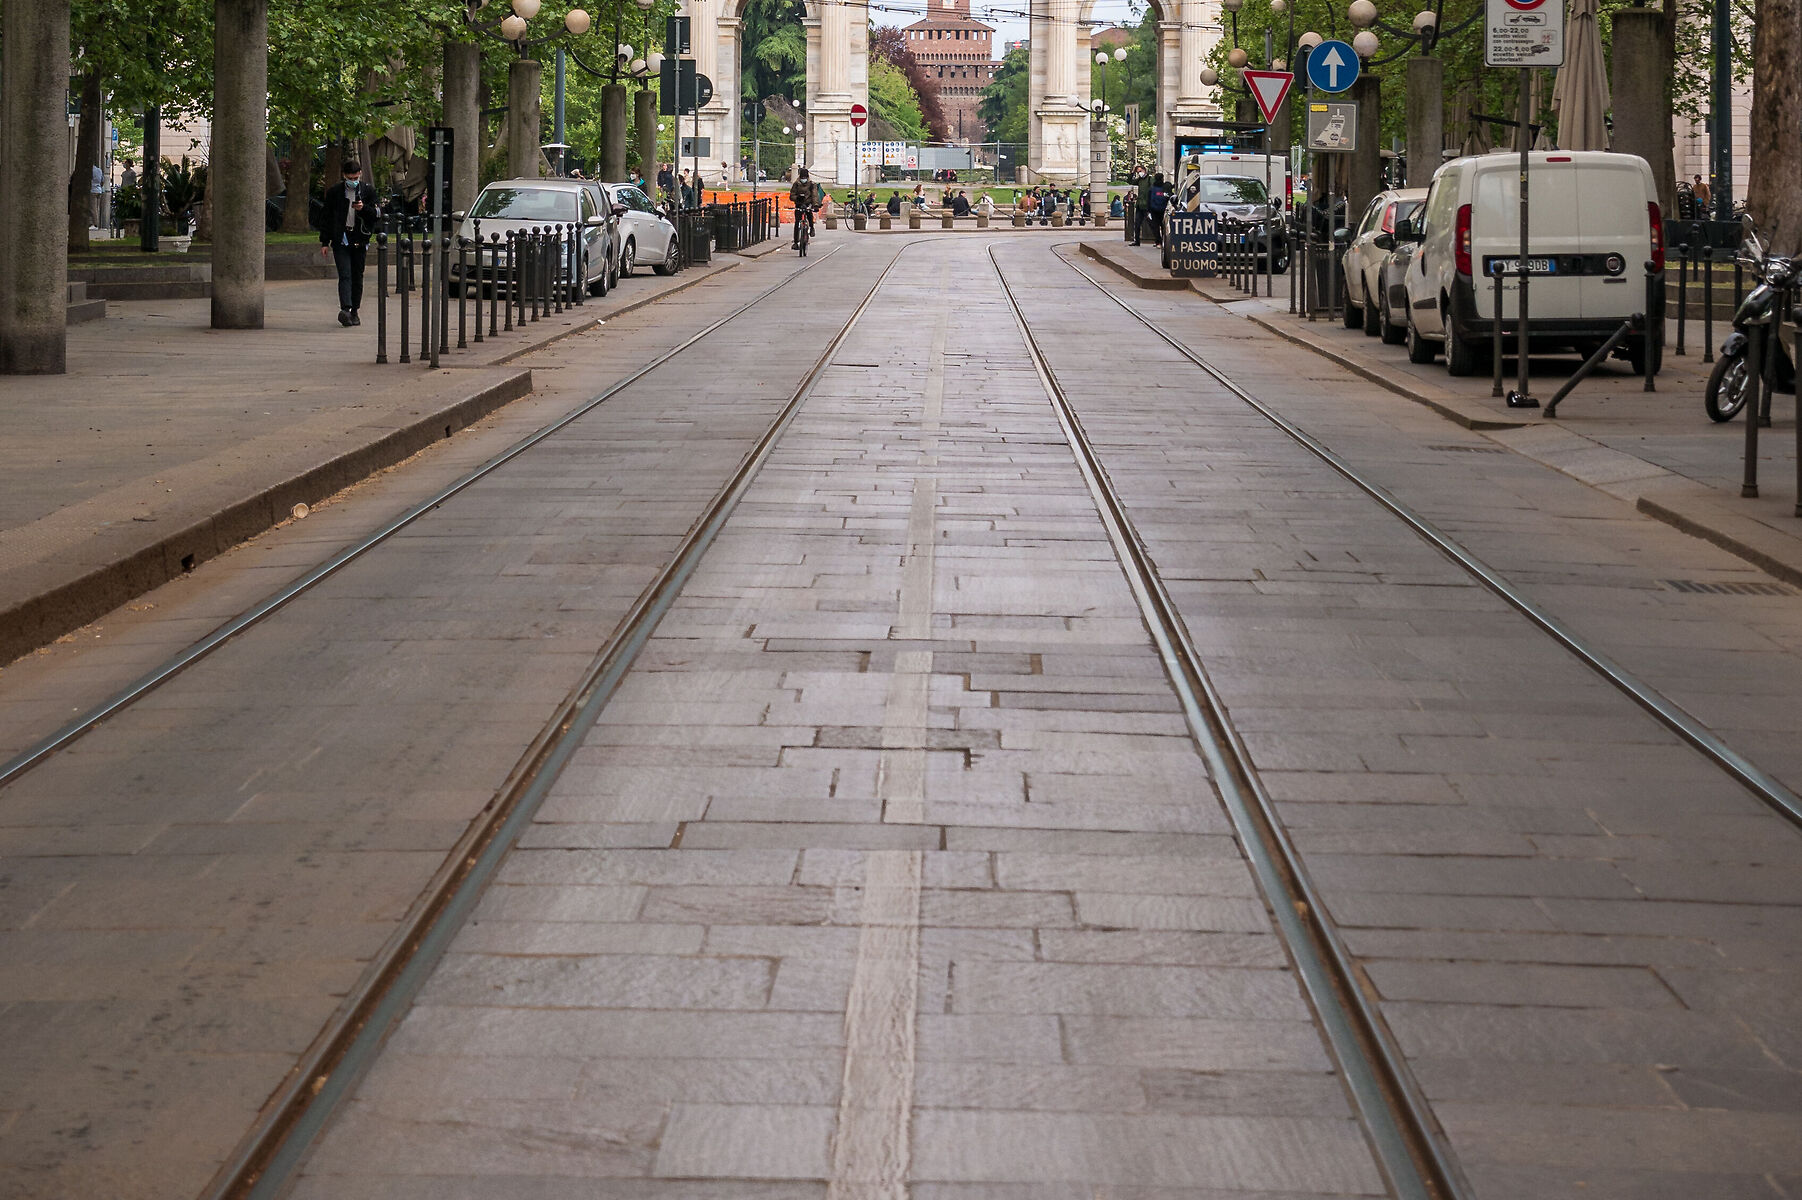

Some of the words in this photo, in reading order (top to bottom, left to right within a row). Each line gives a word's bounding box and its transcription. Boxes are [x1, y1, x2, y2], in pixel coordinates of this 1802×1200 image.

[1172, 219, 1215, 234] TRAM
[1180, 241, 1217, 253] PASSO
[1171, 259, 1217, 271] D'UOMO
